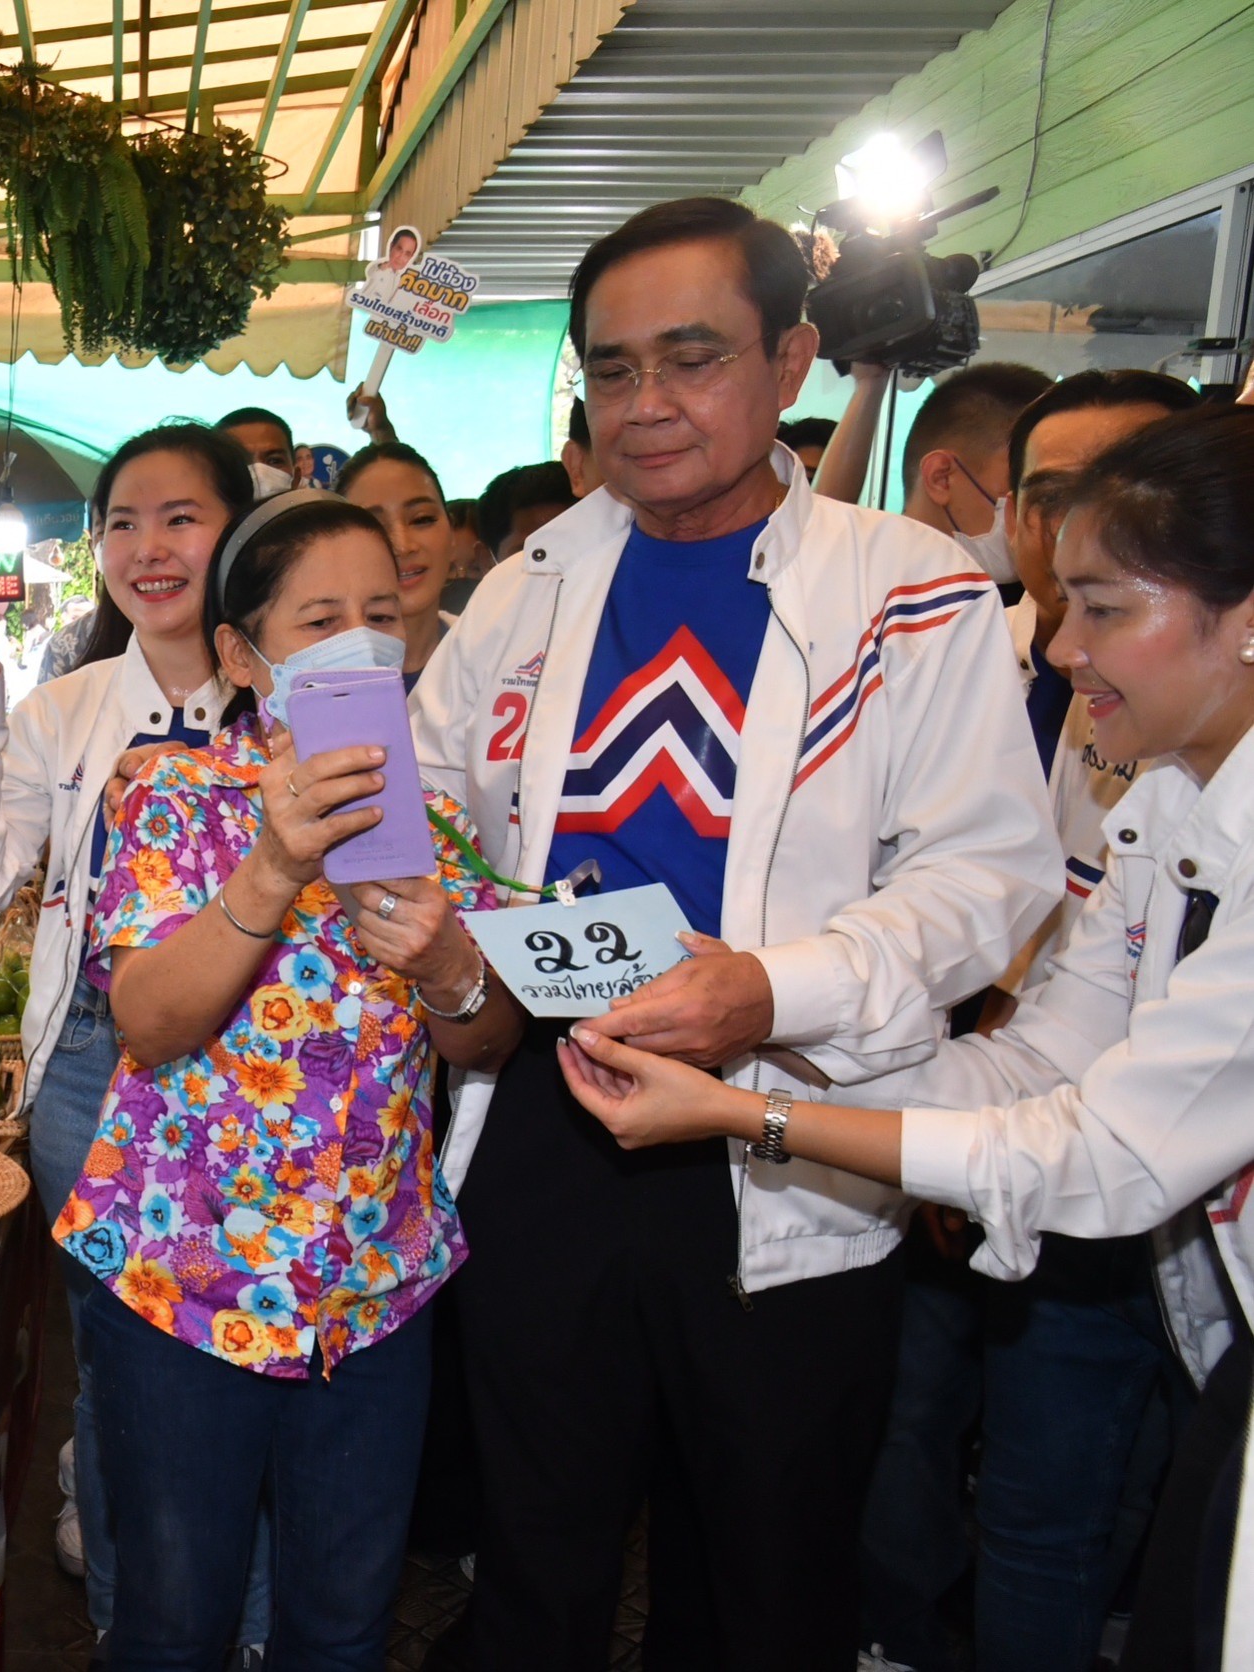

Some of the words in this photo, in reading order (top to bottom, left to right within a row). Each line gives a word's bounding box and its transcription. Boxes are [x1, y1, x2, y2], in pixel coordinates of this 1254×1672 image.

[399, 269, 469, 312] คิดมาก
[421, 257, 477, 292] ไม่ต้อง
[350, 291, 448, 338] รวมไทยสร้างชาติ
[413, 300, 452, 324] เลือก
[486, 691, 528, 761] 2
